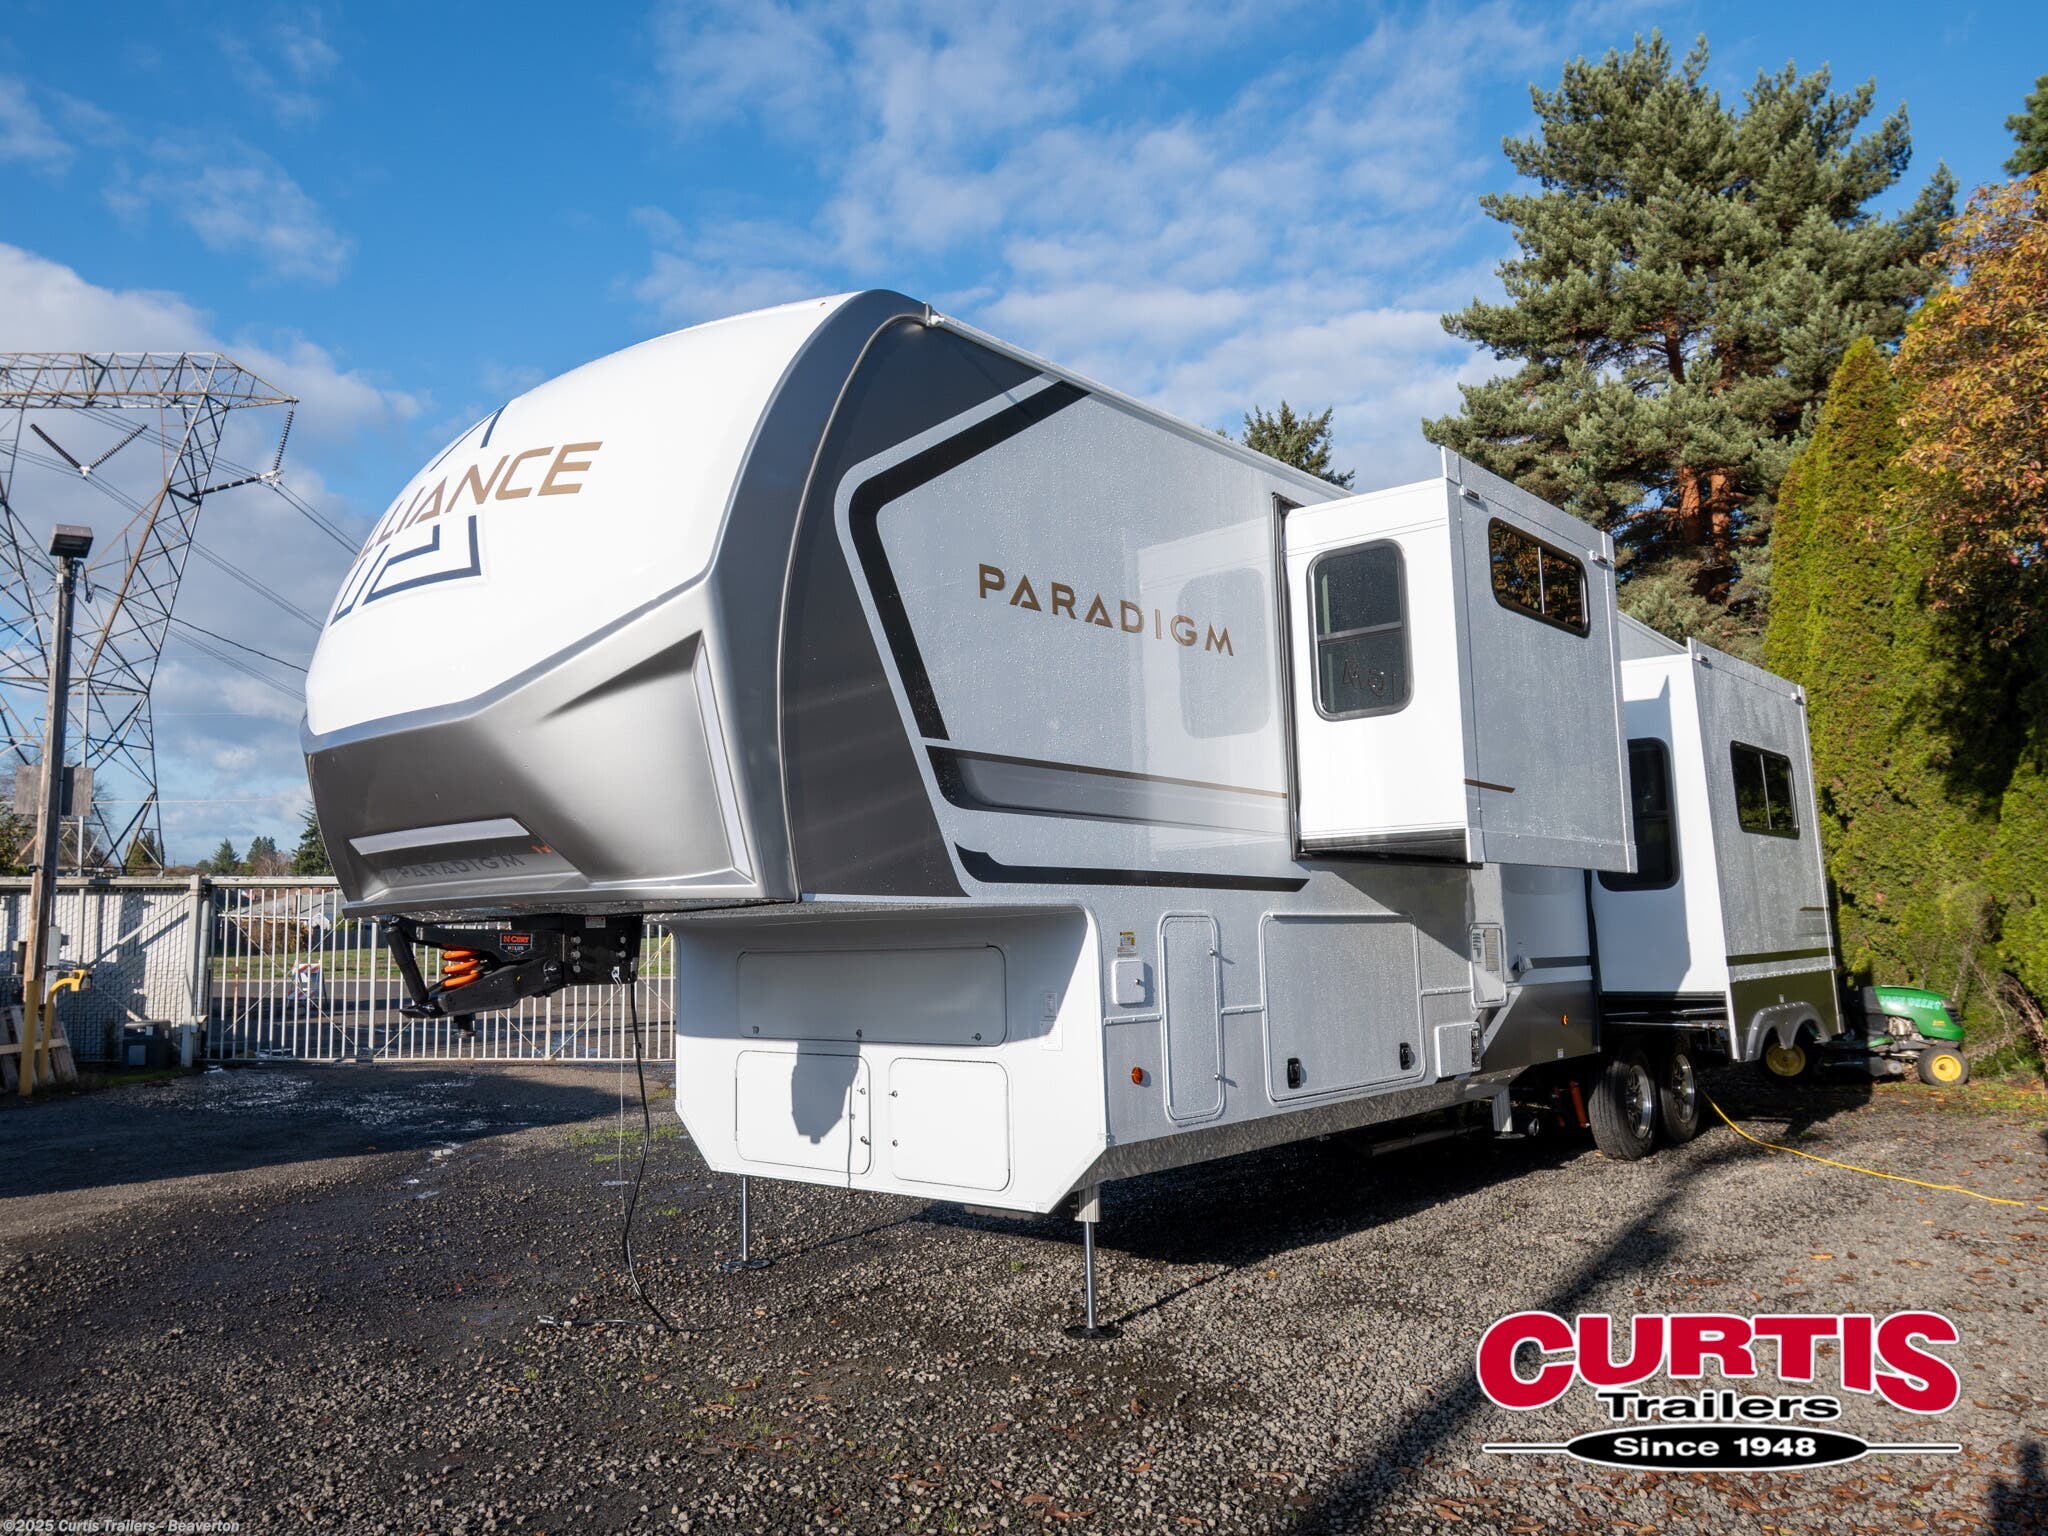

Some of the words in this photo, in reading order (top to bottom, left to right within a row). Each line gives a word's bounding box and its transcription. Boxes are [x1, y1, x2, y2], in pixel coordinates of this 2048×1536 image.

[349, 441, 603, 566] LLIANCE
[979, 563, 1234, 656] PARADIGM
[398, 853, 526, 879] PARADIGM
